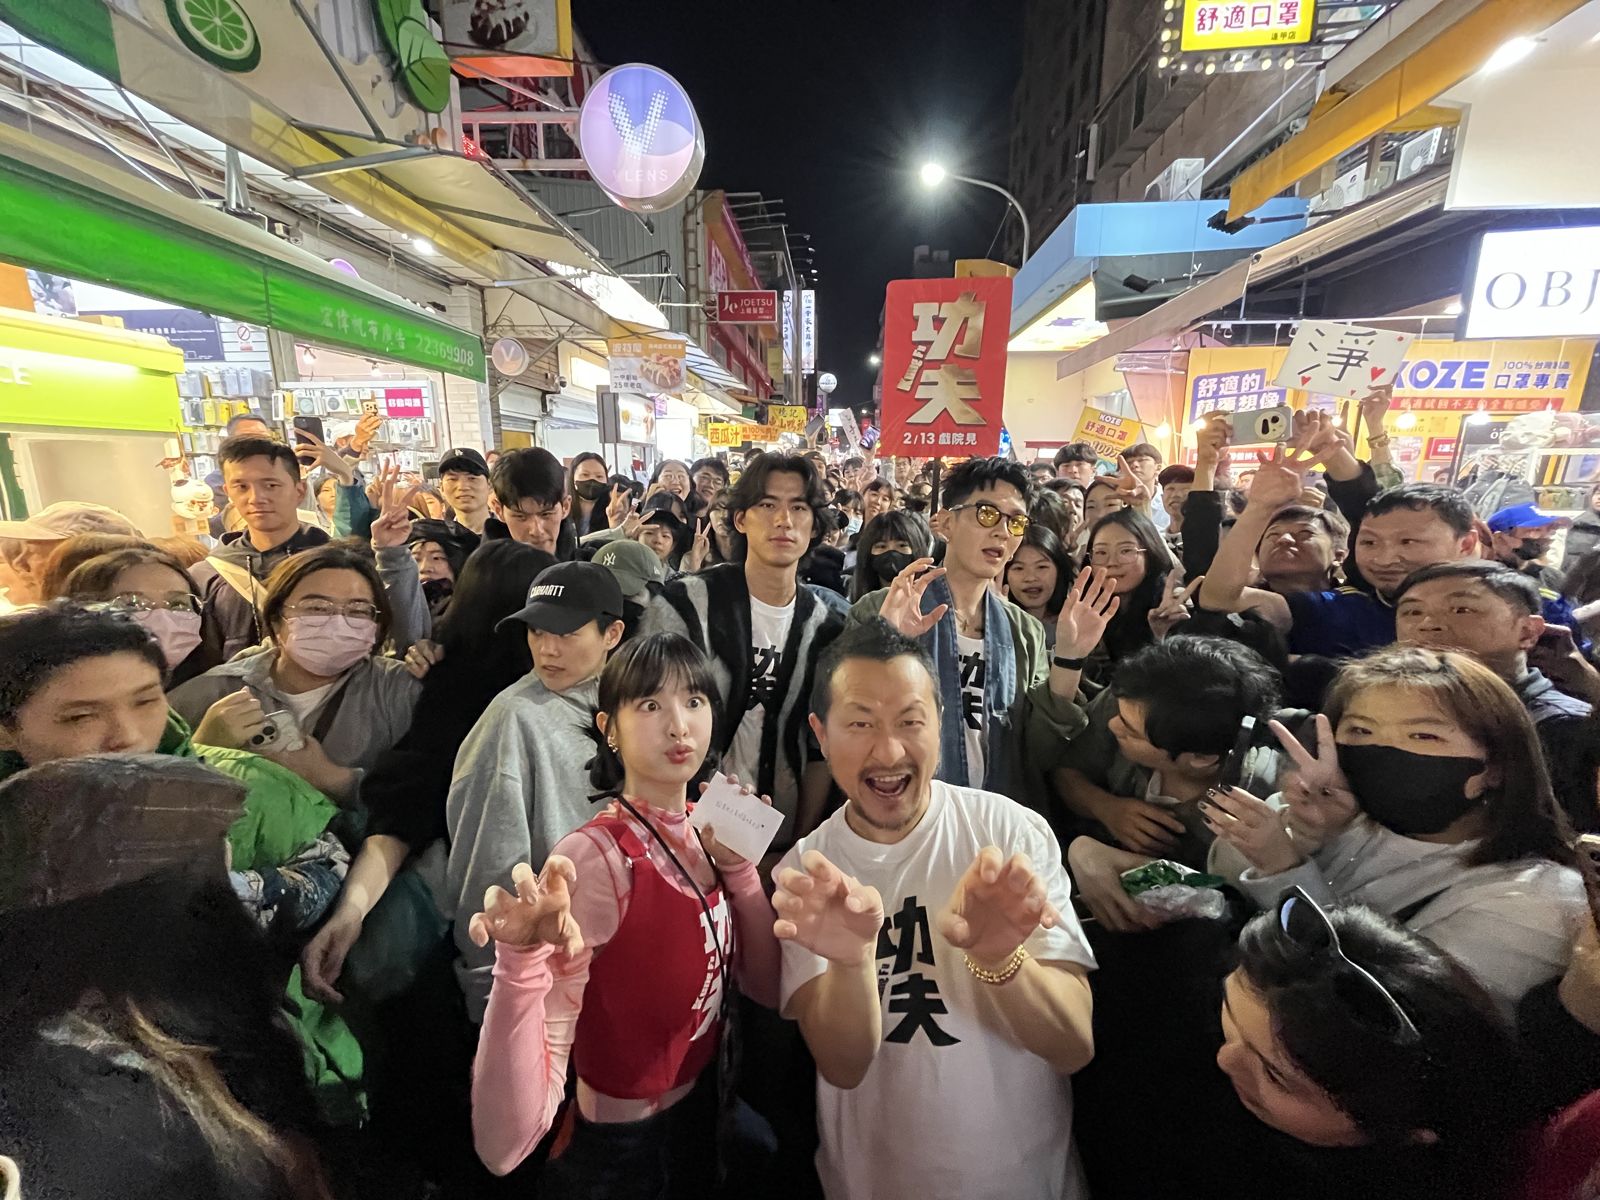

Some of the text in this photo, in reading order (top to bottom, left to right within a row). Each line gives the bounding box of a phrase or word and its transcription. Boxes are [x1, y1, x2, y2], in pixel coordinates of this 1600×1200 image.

[1197, 2, 1299, 32] 舒適口罩
[740, 298, 773, 307] JOETSU
[415, 334, 474, 367] 22369908
[906, 291, 988, 425] 功夫
[1197, 373, 1261, 399] 舒適的
[1494, 373, 1571, 389] 口罩專賣
[710, 427, 740, 445] 西瓜汁
[903, 432, 977, 445] 2/13 戲院見
[873, 895, 962, 1047] 功夫
